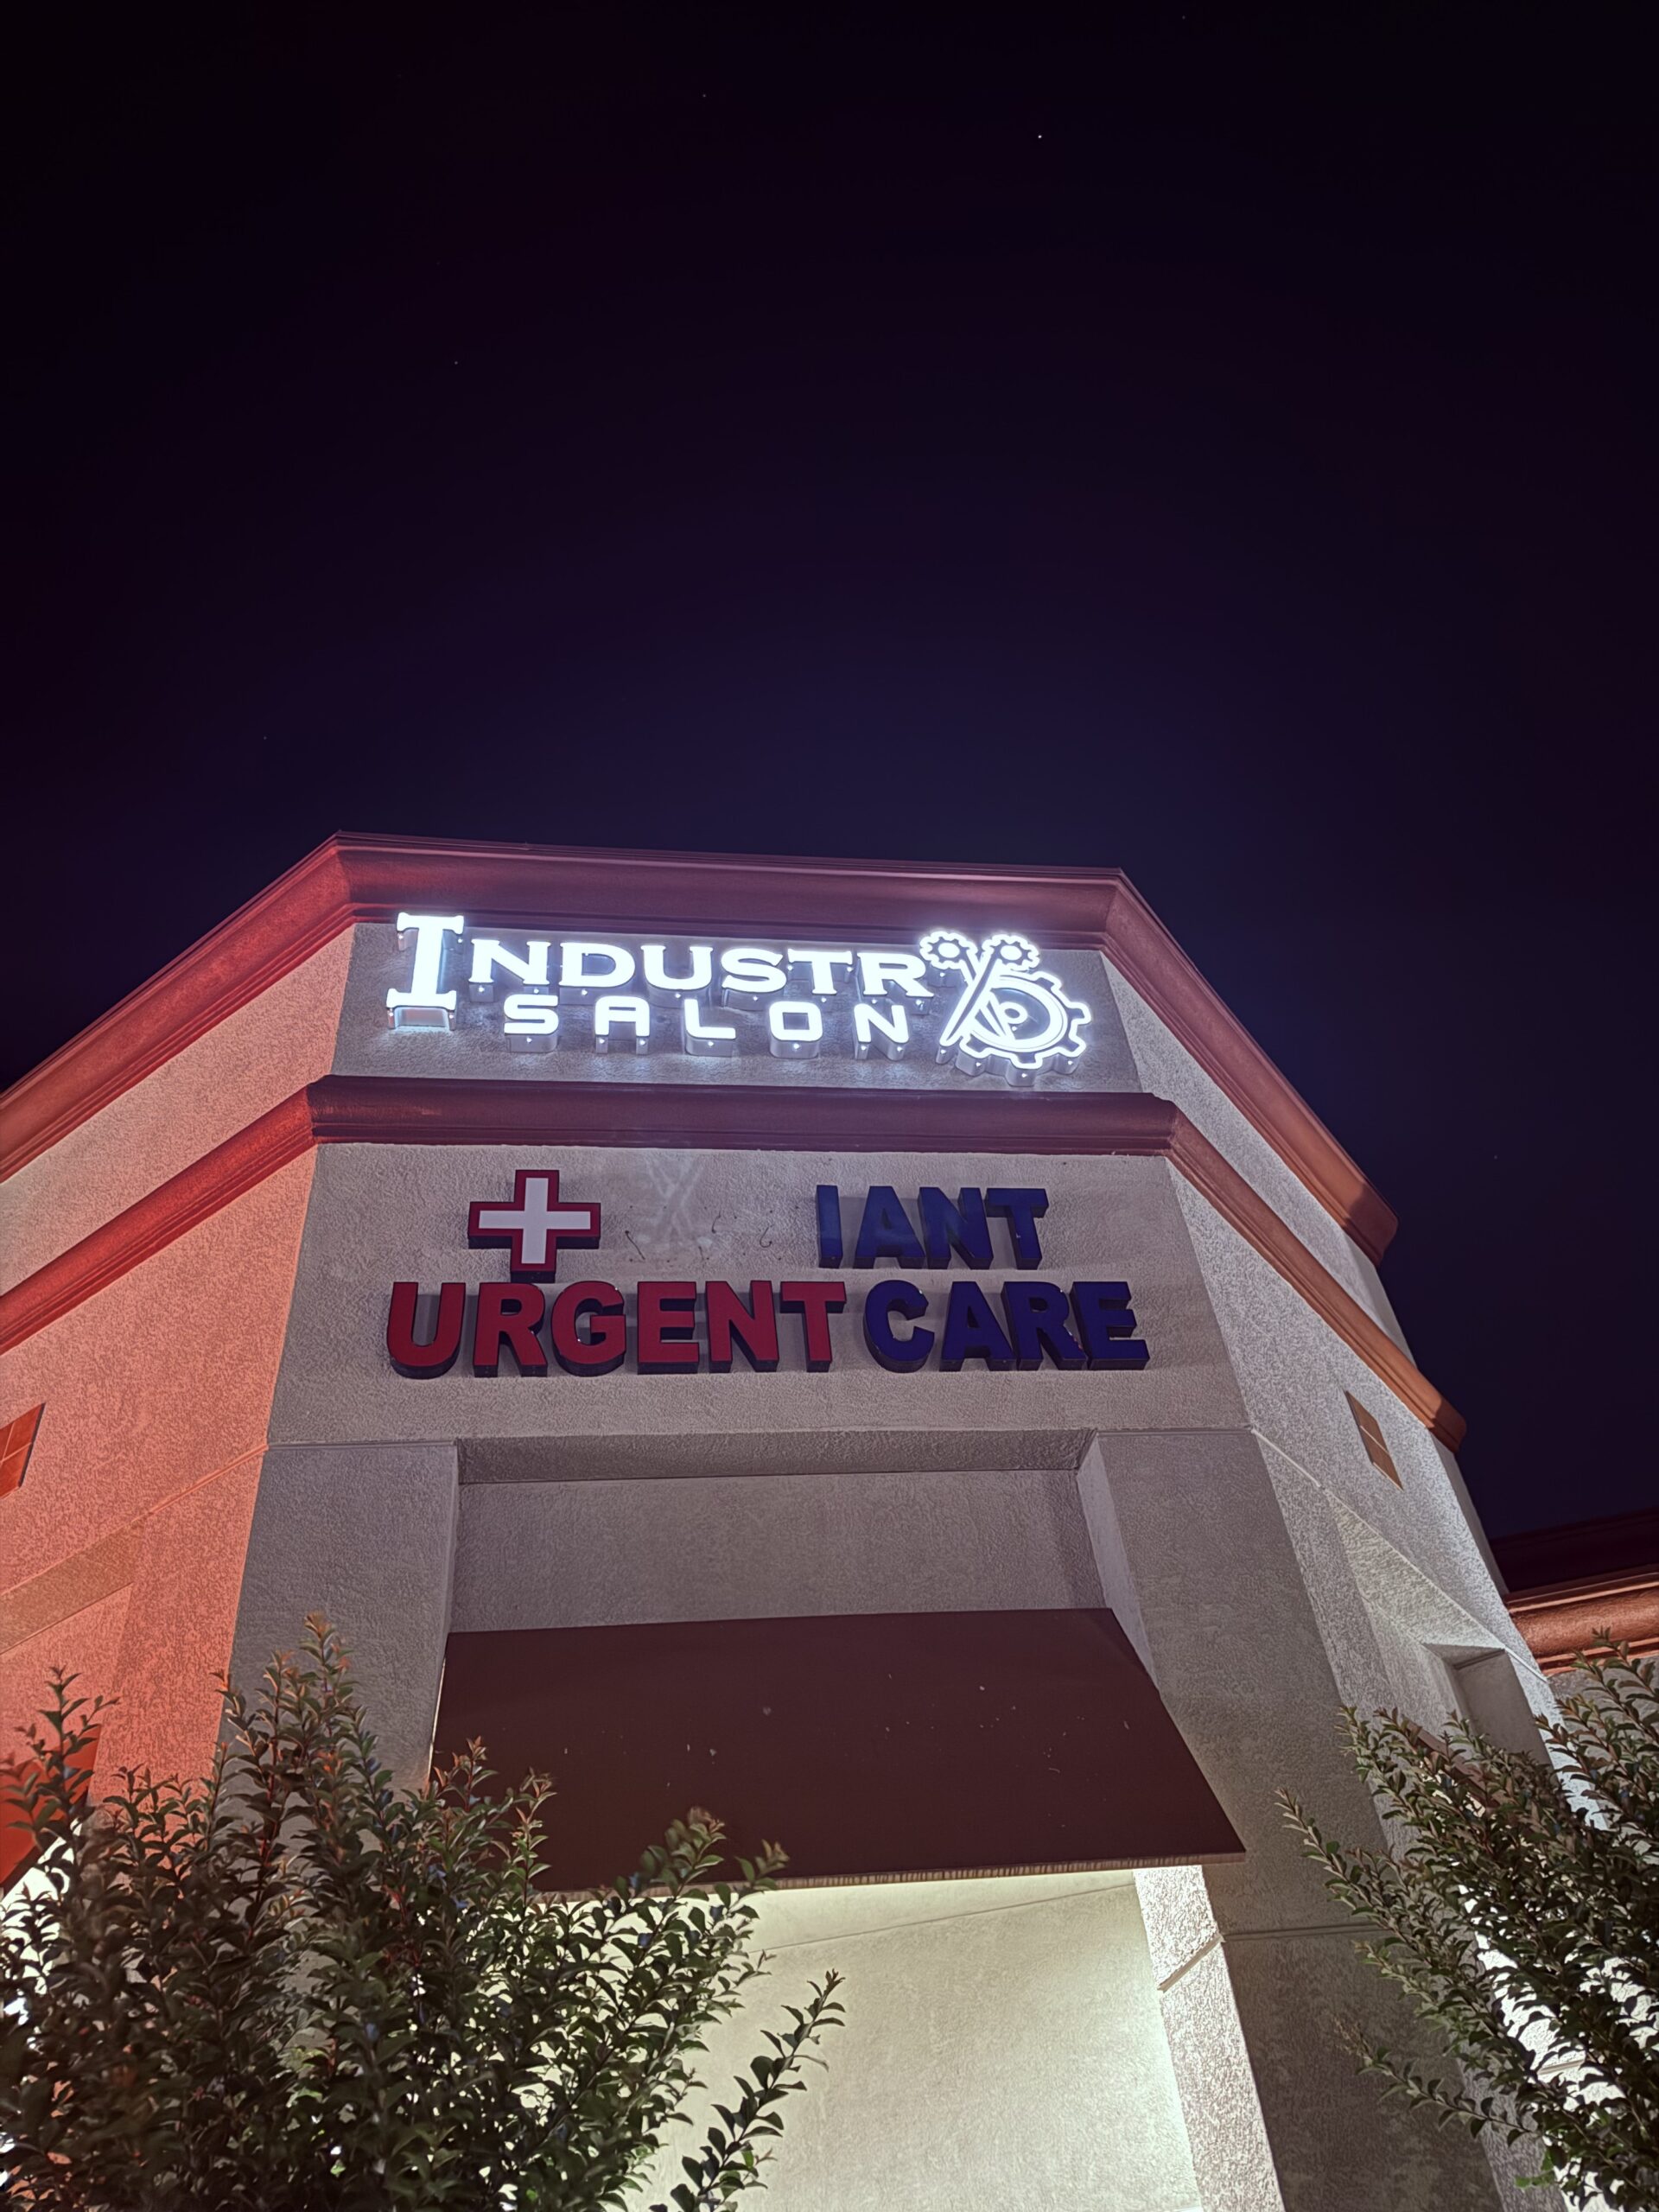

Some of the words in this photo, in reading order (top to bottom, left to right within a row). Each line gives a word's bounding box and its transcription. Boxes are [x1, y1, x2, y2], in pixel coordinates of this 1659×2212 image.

[503, 993, 911, 1046] SALON
[816, 1185, 1049, 1270] IANT
[386, 1280, 847, 1379] URGENT
[864, 1280, 1150, 1373] CARE
